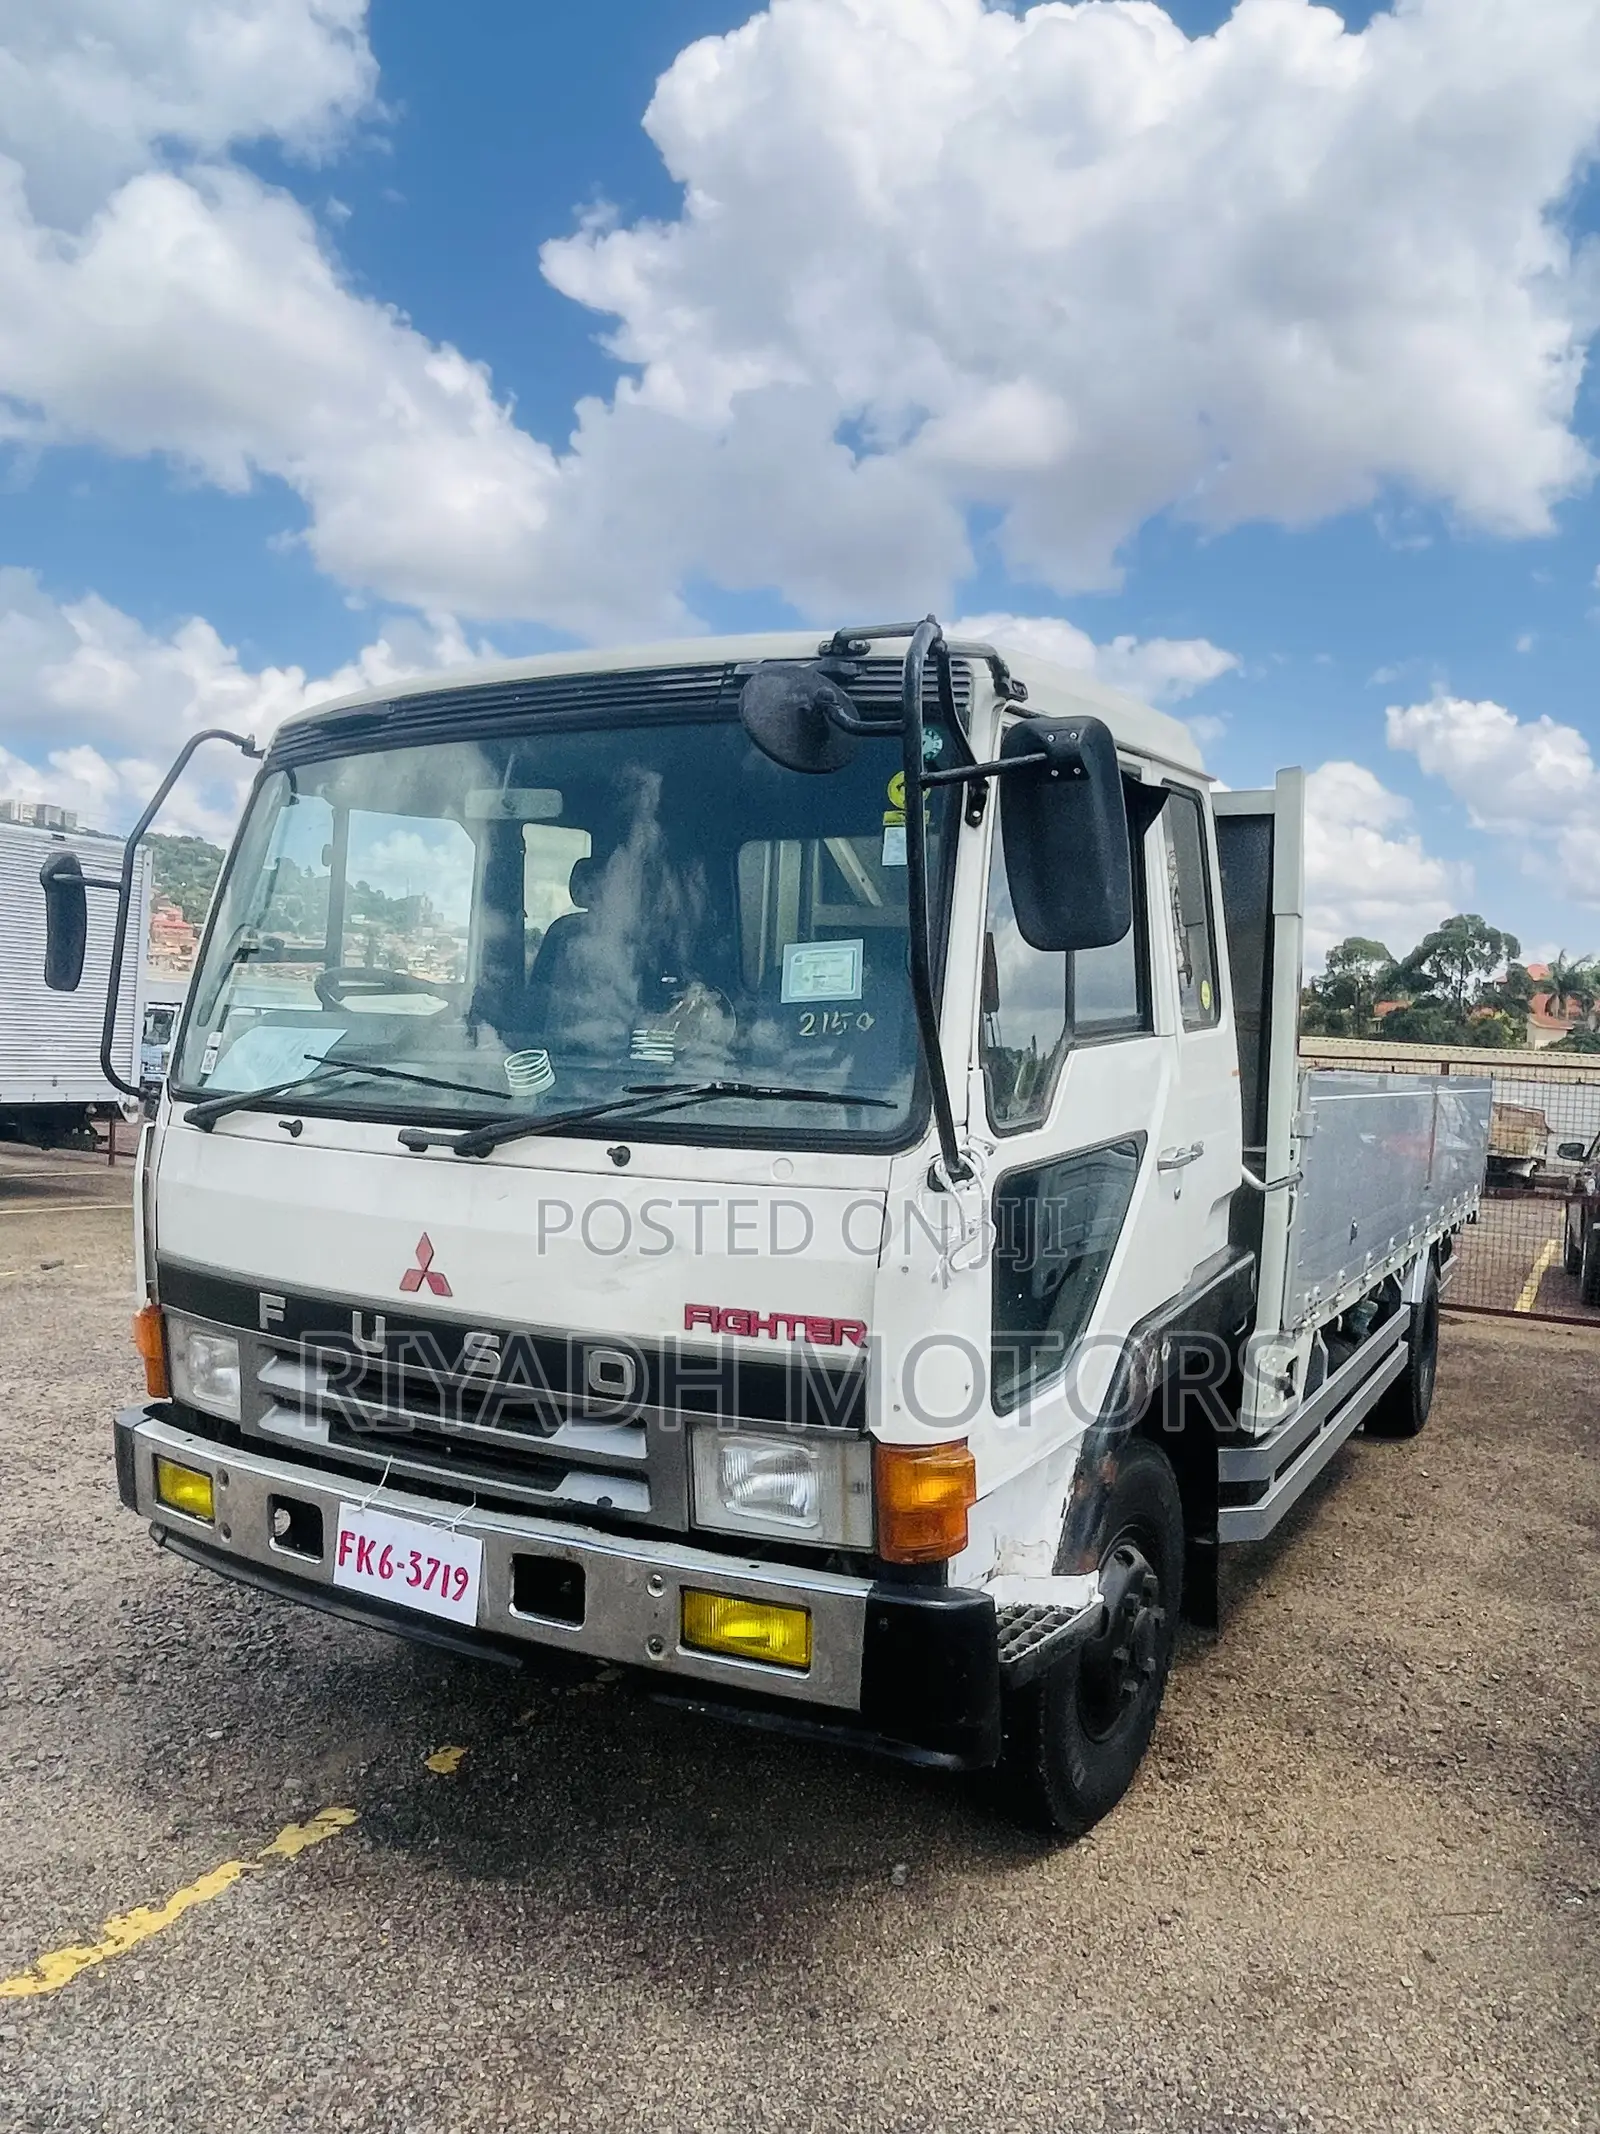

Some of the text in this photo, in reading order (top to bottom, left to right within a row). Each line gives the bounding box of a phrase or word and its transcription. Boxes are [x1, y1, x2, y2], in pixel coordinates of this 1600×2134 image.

[799, 1011, 876, 1036] 2150
[258, 1292, 637, 1396] FUSO
[684, 1303, 869, 1349] FIGHTER
[338, 1529, 469, 1602] FK6-3719
